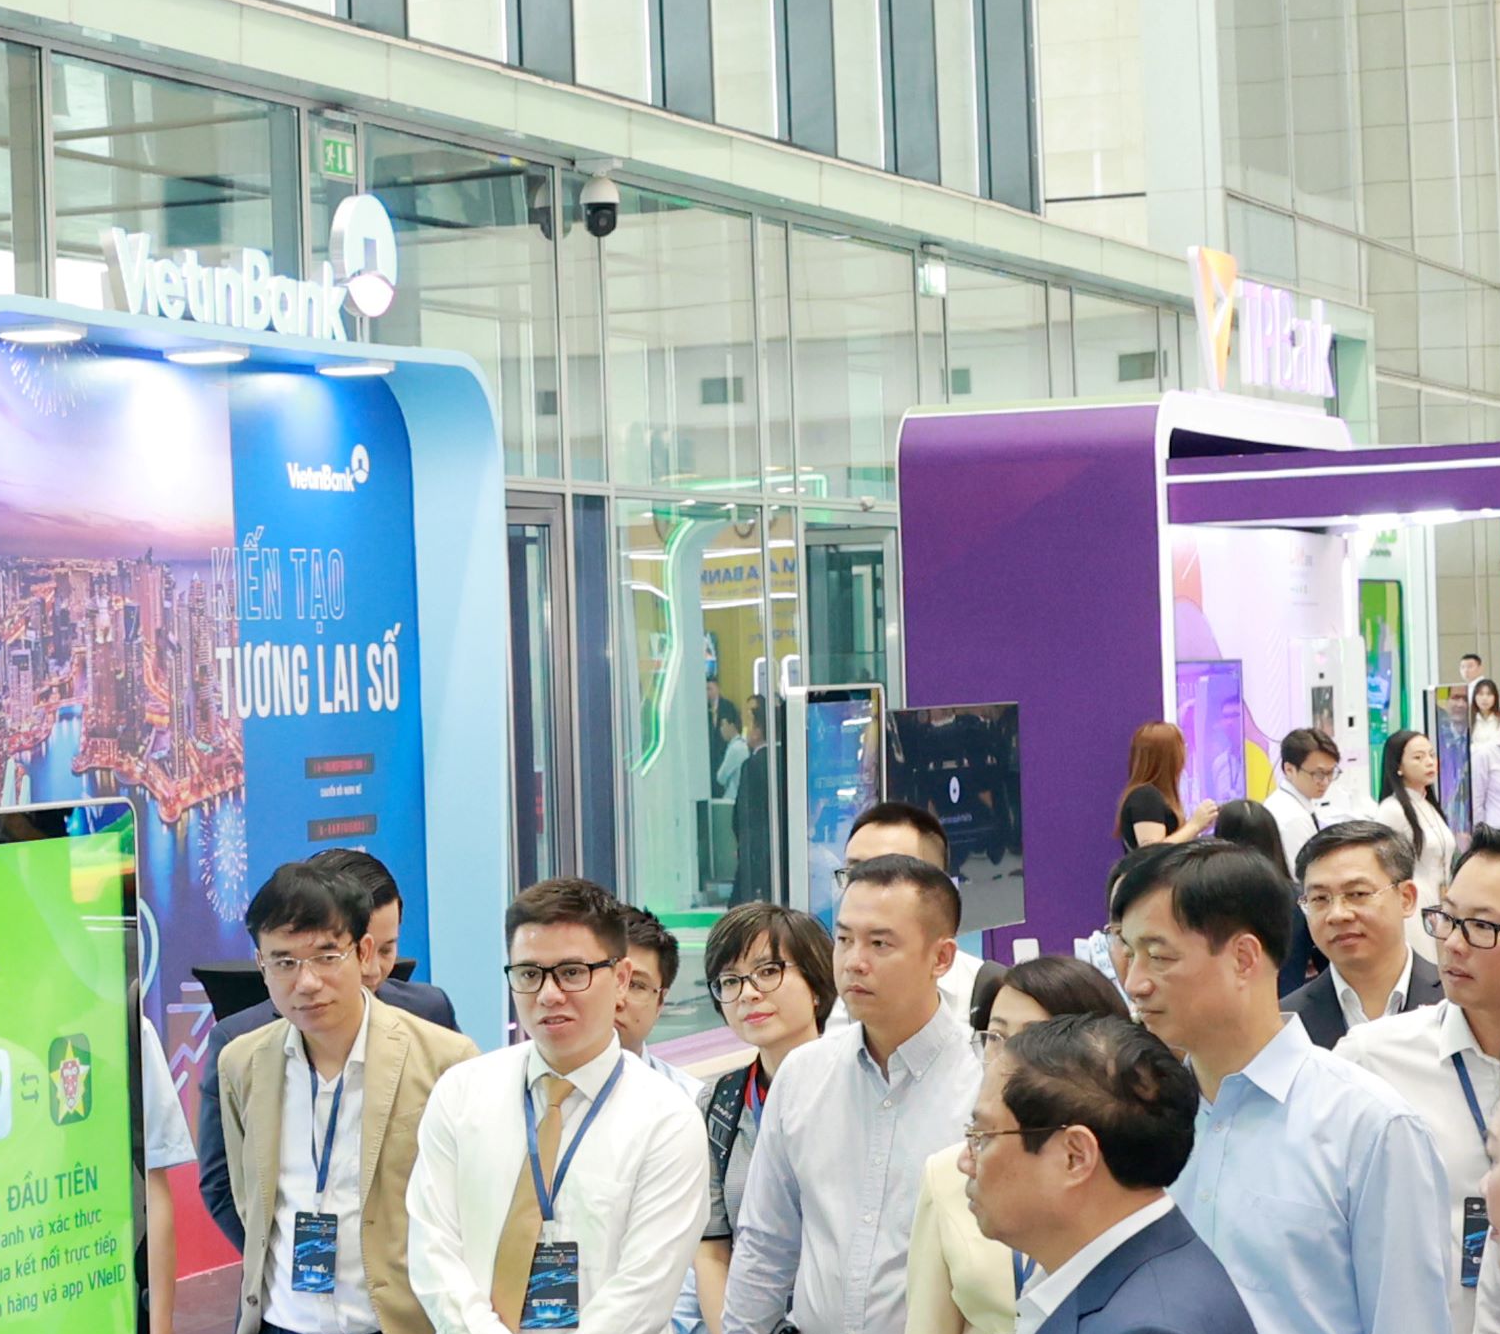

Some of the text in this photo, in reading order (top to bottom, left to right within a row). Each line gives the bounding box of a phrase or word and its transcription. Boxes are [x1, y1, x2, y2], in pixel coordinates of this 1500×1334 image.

[106, 226, 348, 342] VietinBank
[286, 462, 355, 492] VietinBank
[211, 525, 345, 635] KIẾN TẠO
[215, 622, 402, 720] TƯƠNG LAI SỐ
[6, 1170, 48, 1212] ĐẦU
[55, 1162, 98, 1200] TIÊN
[28, 1218, 44, 1239] và
[48, 1214, 70, 1237] xác
[74, 1207, 103, 1232] thực
[15, 1254, 37, 1279] kết
[41, 1246, 61, 1269] nối
[65, 1243, 90, 1266] trực
[94, 1231, 118, 1259] tiếp
[6, 1291, 38, 1317] hàng
[43, 1285, 58, 1304] và
[62, 1280, 84, 1302] app
[87, 1263, 127, 1292] VNeID
